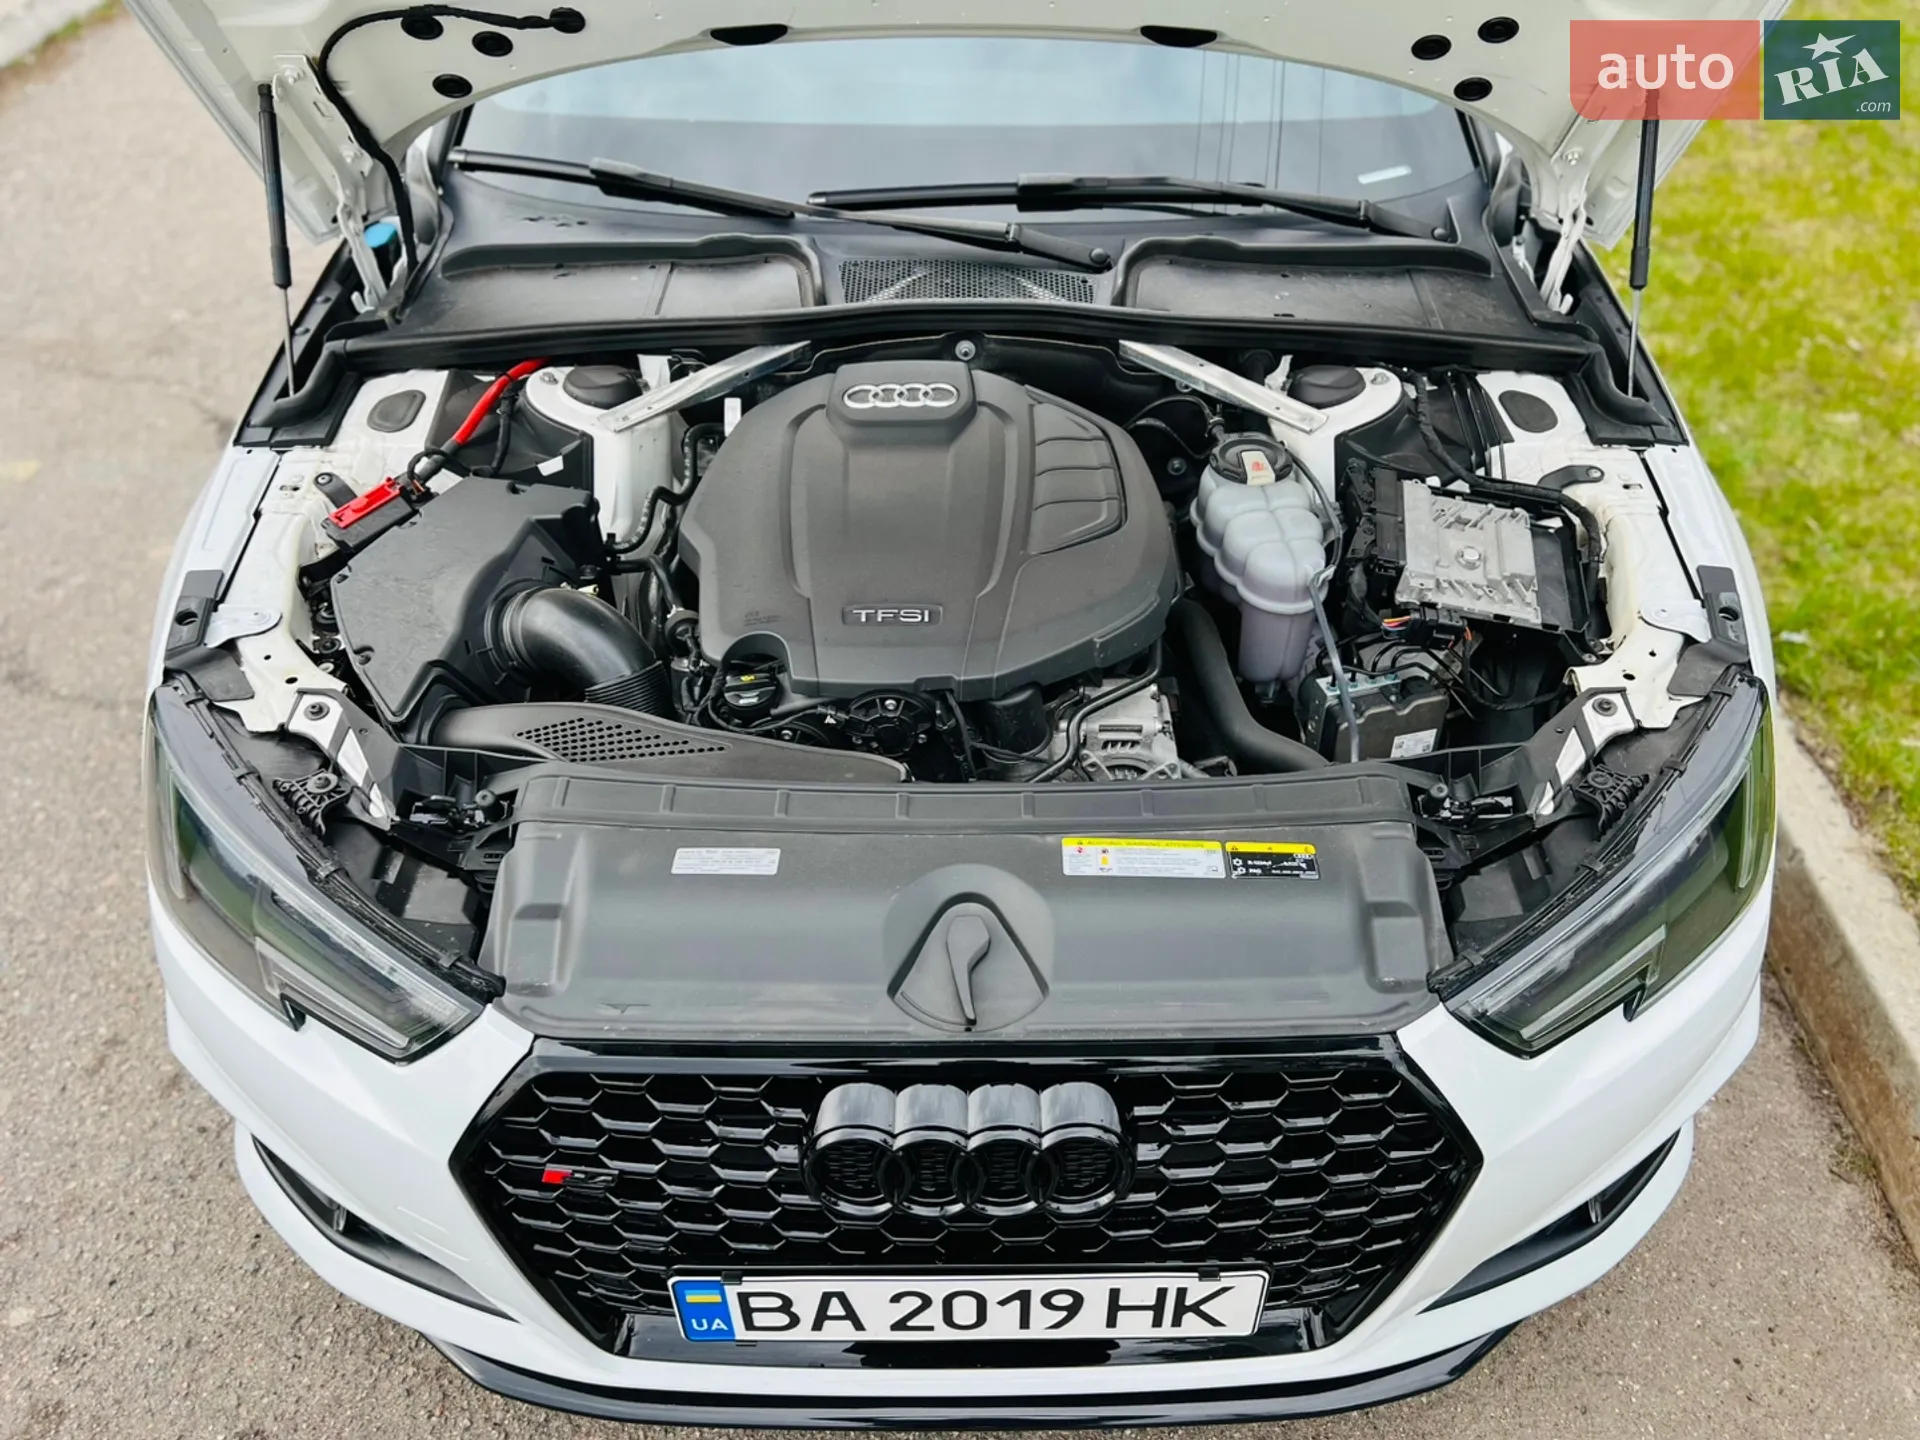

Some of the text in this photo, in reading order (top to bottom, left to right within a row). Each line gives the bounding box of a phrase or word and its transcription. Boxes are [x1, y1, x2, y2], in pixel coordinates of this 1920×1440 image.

[851, 609, 930, 623] TFSI
[736, 1285, 1237, 1332] BA 2019 HK
[691, 1317, 729, 1332] UA
